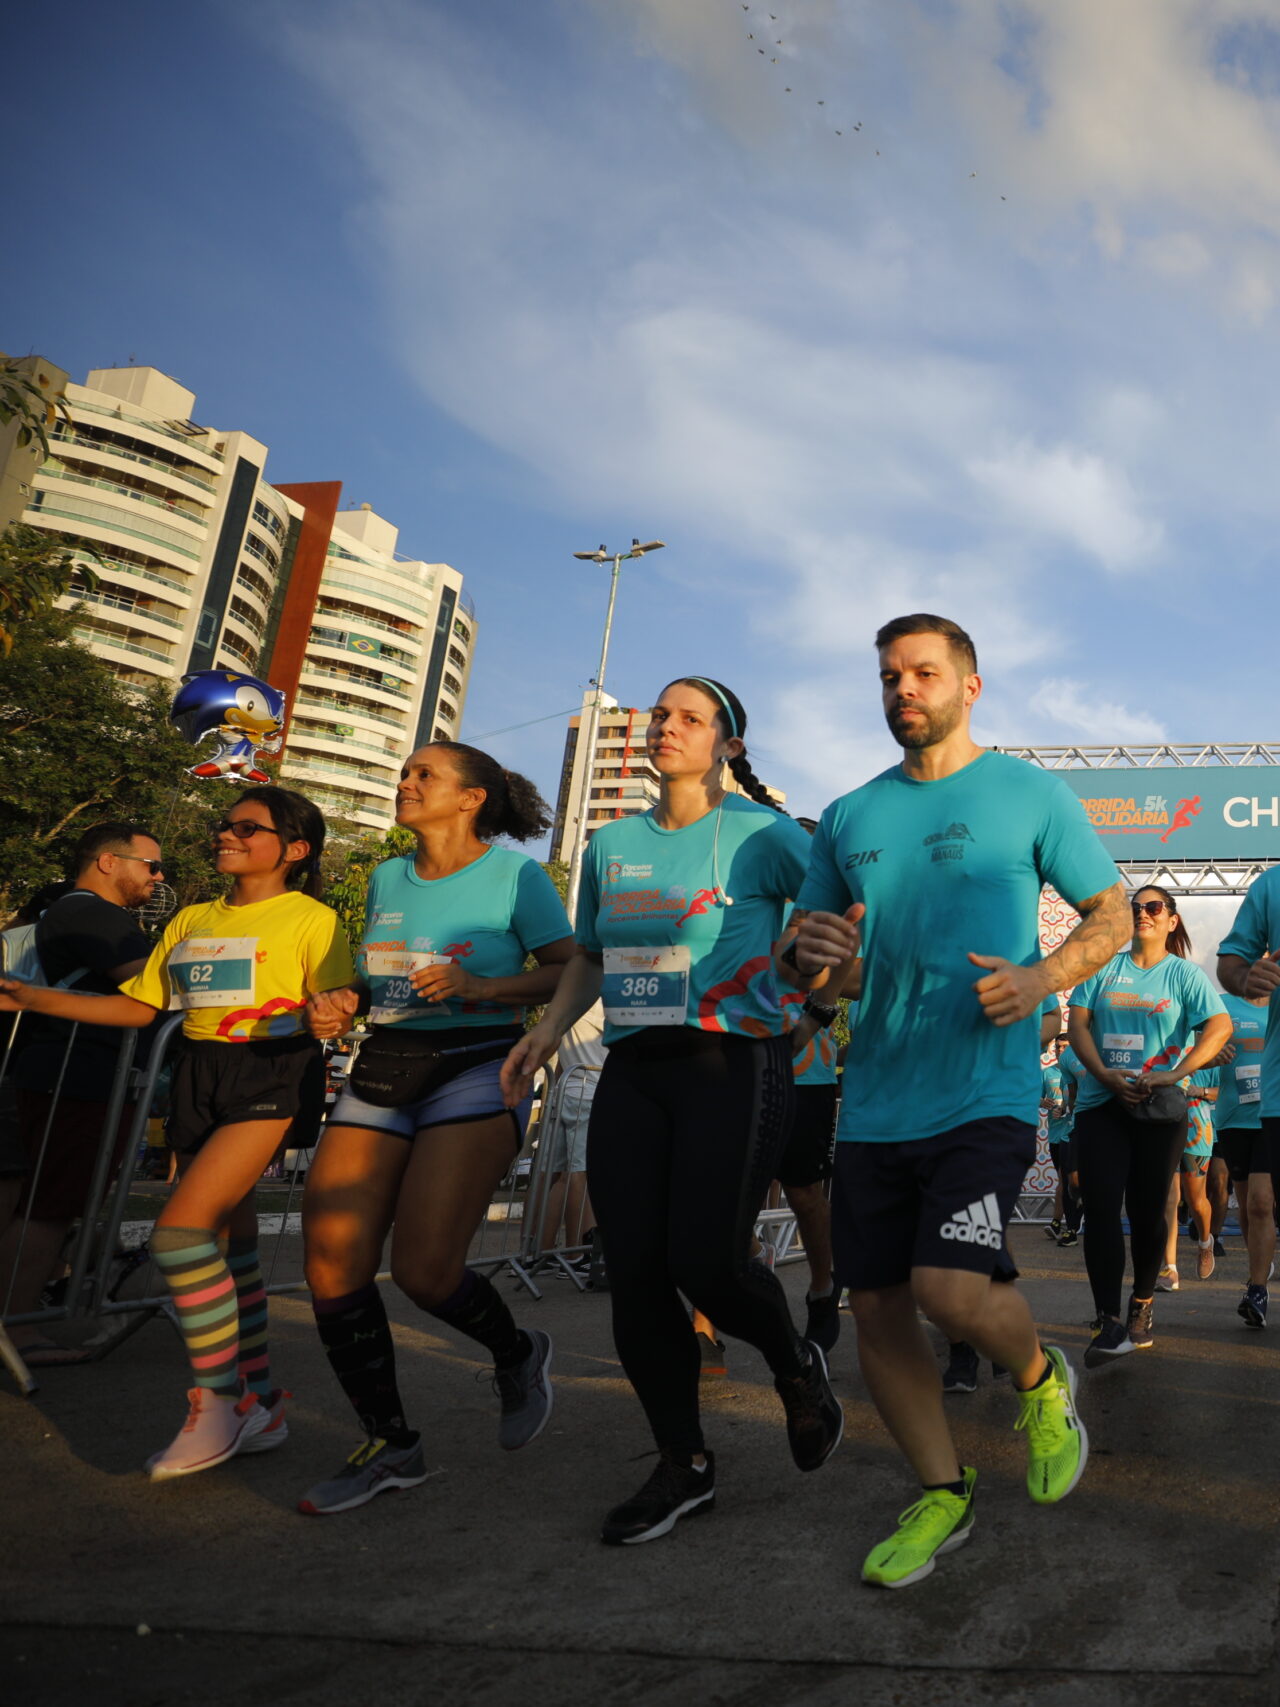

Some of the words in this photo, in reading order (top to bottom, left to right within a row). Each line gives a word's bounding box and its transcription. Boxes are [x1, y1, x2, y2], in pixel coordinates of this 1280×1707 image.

[1144, 796, 1168, 811] 5k
[189, 964, 214, 983] 62
[385, 979, 411, 999] 329
[620, 977, 659, 997] 386
[1109, 1051, 1131, 1063] 366
[939, 1222, 1002, 1250] adidas
